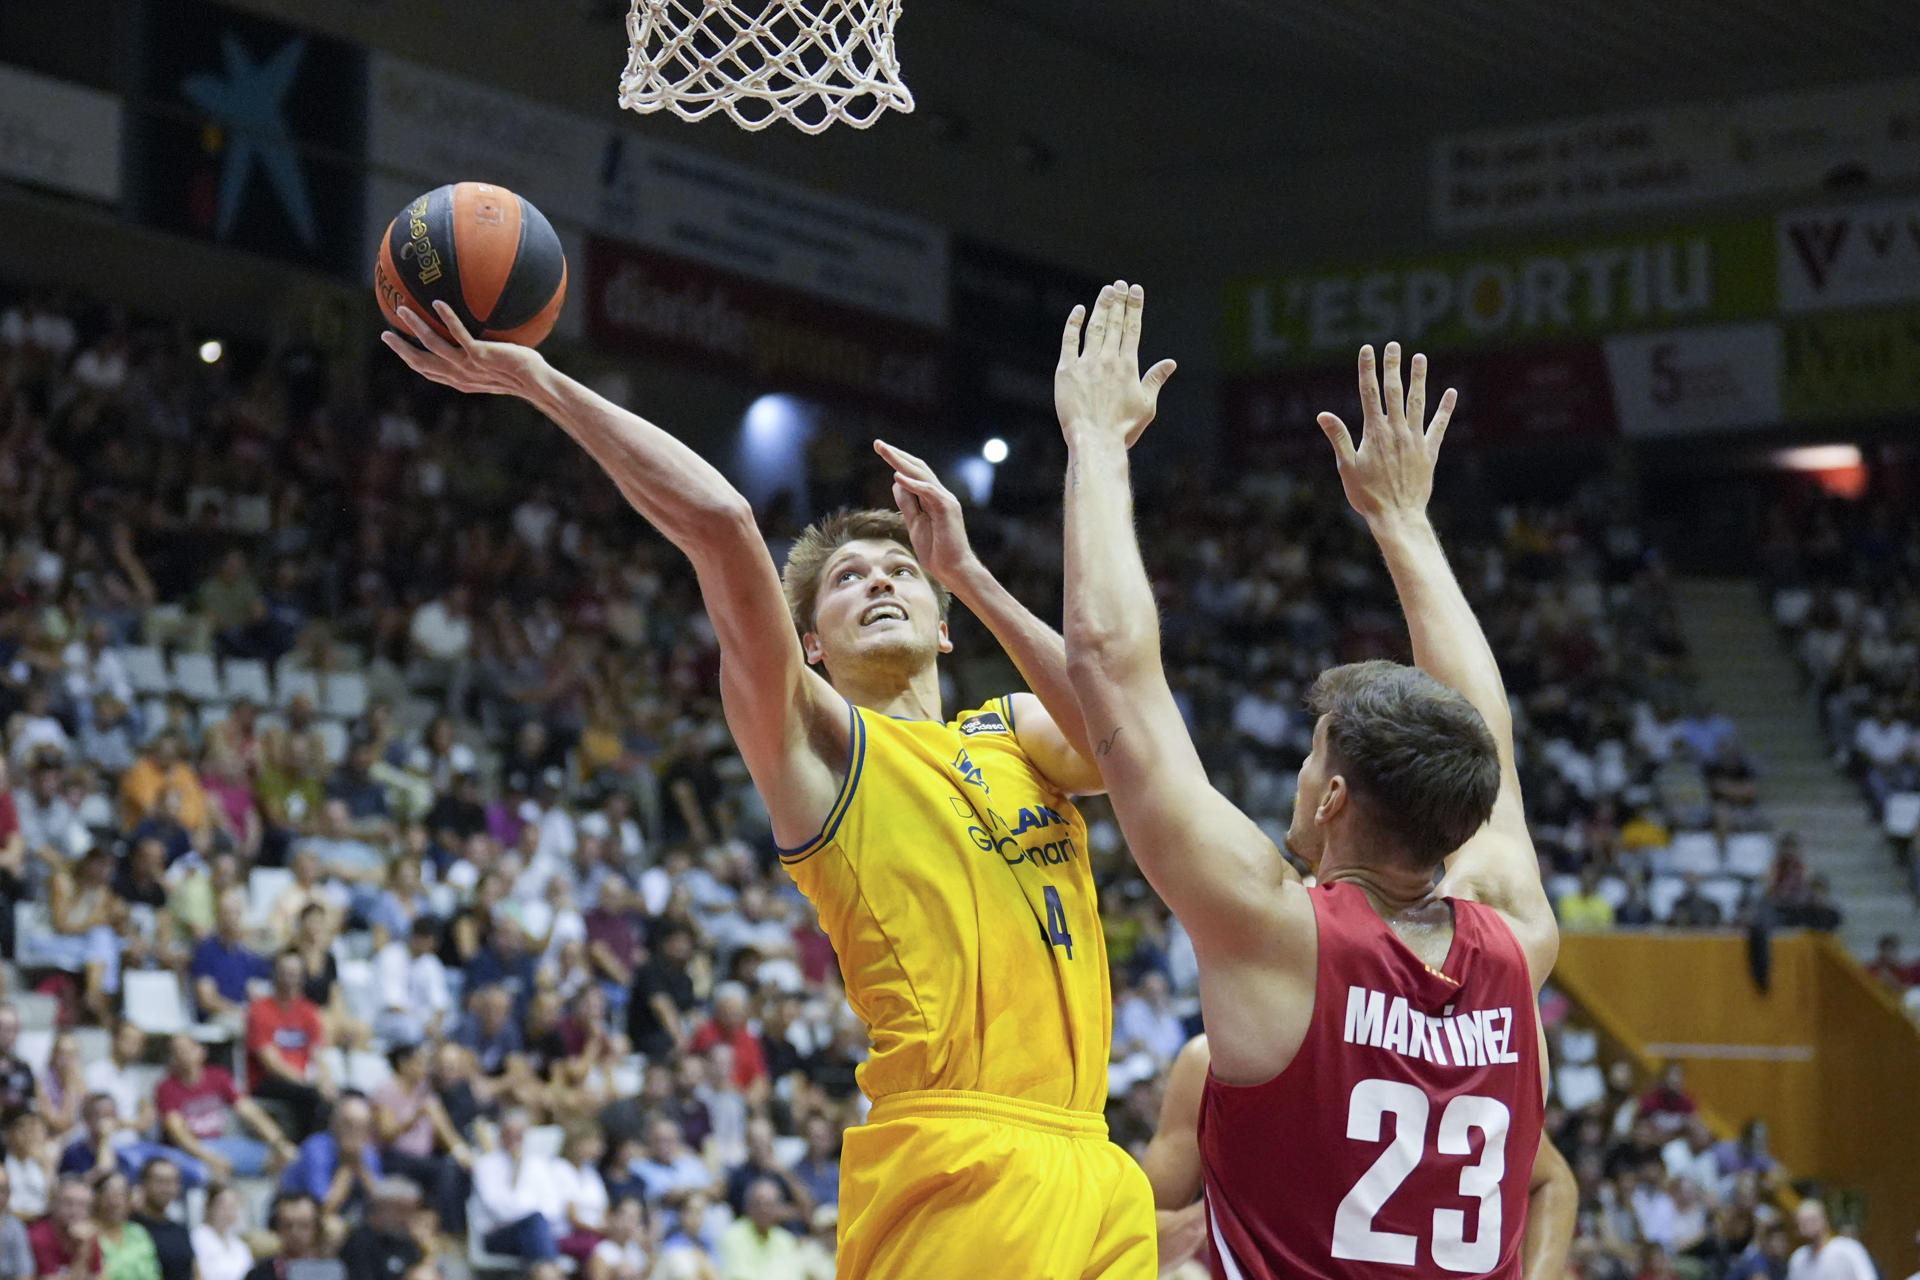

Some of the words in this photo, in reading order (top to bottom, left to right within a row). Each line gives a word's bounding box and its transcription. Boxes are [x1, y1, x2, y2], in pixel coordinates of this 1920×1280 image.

[1249, 240, 1714, 355] L'ESPORTIU
[1042, 885, 1074, 961] 4
[1343, 985, 1519, 1067] MARTÍNEZ
[1331, 1078, 1511, 1274] 23
